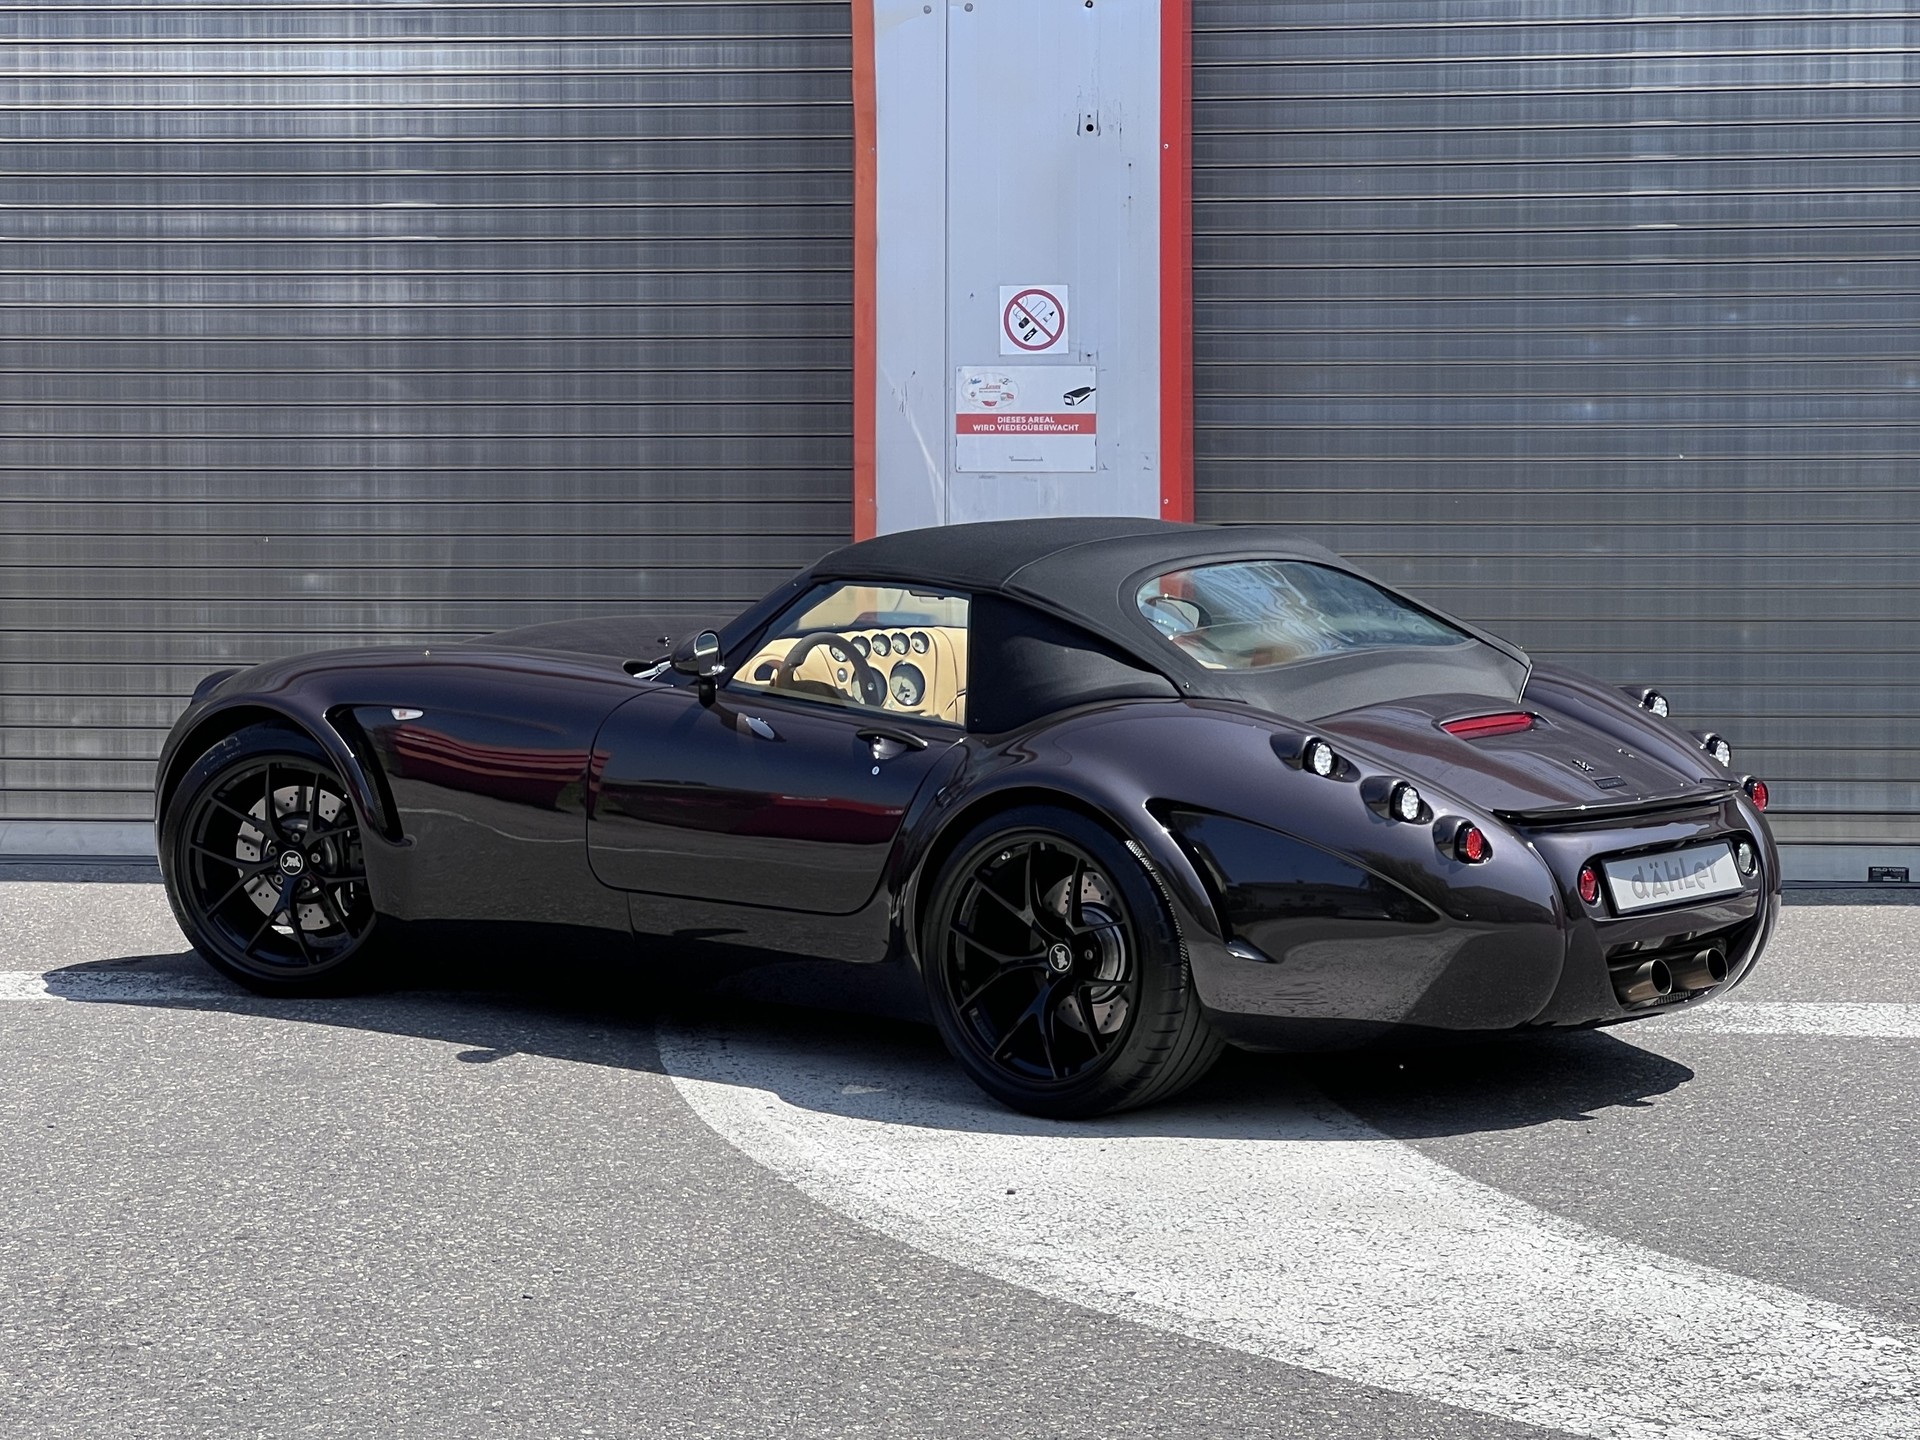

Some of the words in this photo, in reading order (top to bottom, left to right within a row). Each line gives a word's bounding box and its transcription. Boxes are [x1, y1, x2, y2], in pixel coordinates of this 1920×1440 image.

[997, 416, 1026, 424] DIESES
[1028, 416, 1055, 424] AREAL
[997, 422, 1080, 431] VIEDEOÜBERWACHT
